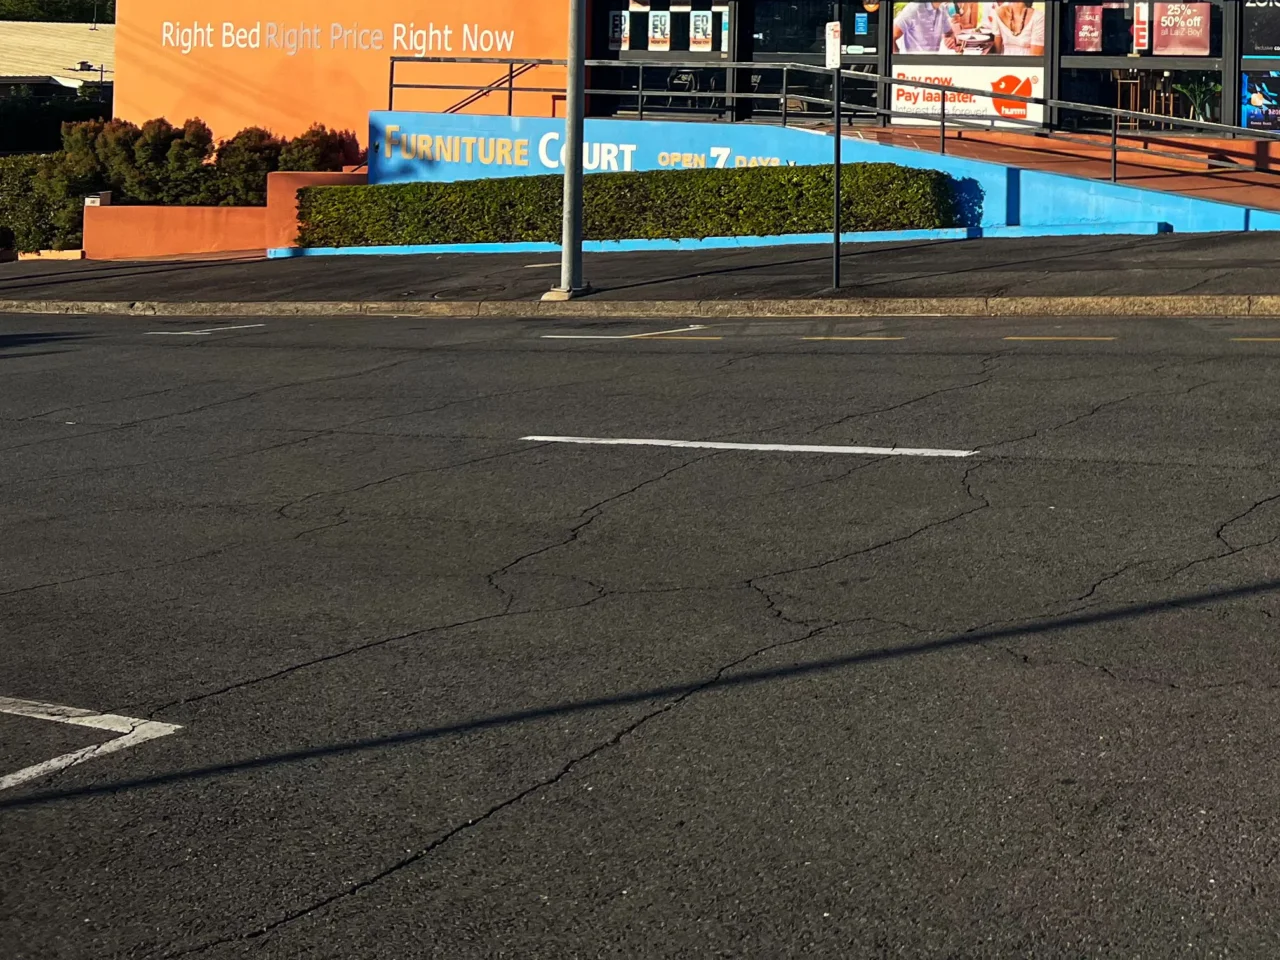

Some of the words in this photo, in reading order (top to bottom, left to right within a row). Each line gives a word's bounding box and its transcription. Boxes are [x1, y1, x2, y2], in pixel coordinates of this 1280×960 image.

[1161, 16, 1185, 28] 50%
[1186, 16, 1203, 27] off
[162, 21, 214, 54] Right
[221, 21, 261, 49] Bed
[266, 22, 321, 56] Right
[330, 22, 384, 50] Price
[392, 23, 452, 58] Right
[461, 24, 514, 52] Now
[896, 88, 919, 105] Pay
[384, 125, 529, 167] FURNITURE
[538, 131, 637, 171] CURT
[657, 152, 707, 168] OPEN
[710, 147, 731, 168] 7
